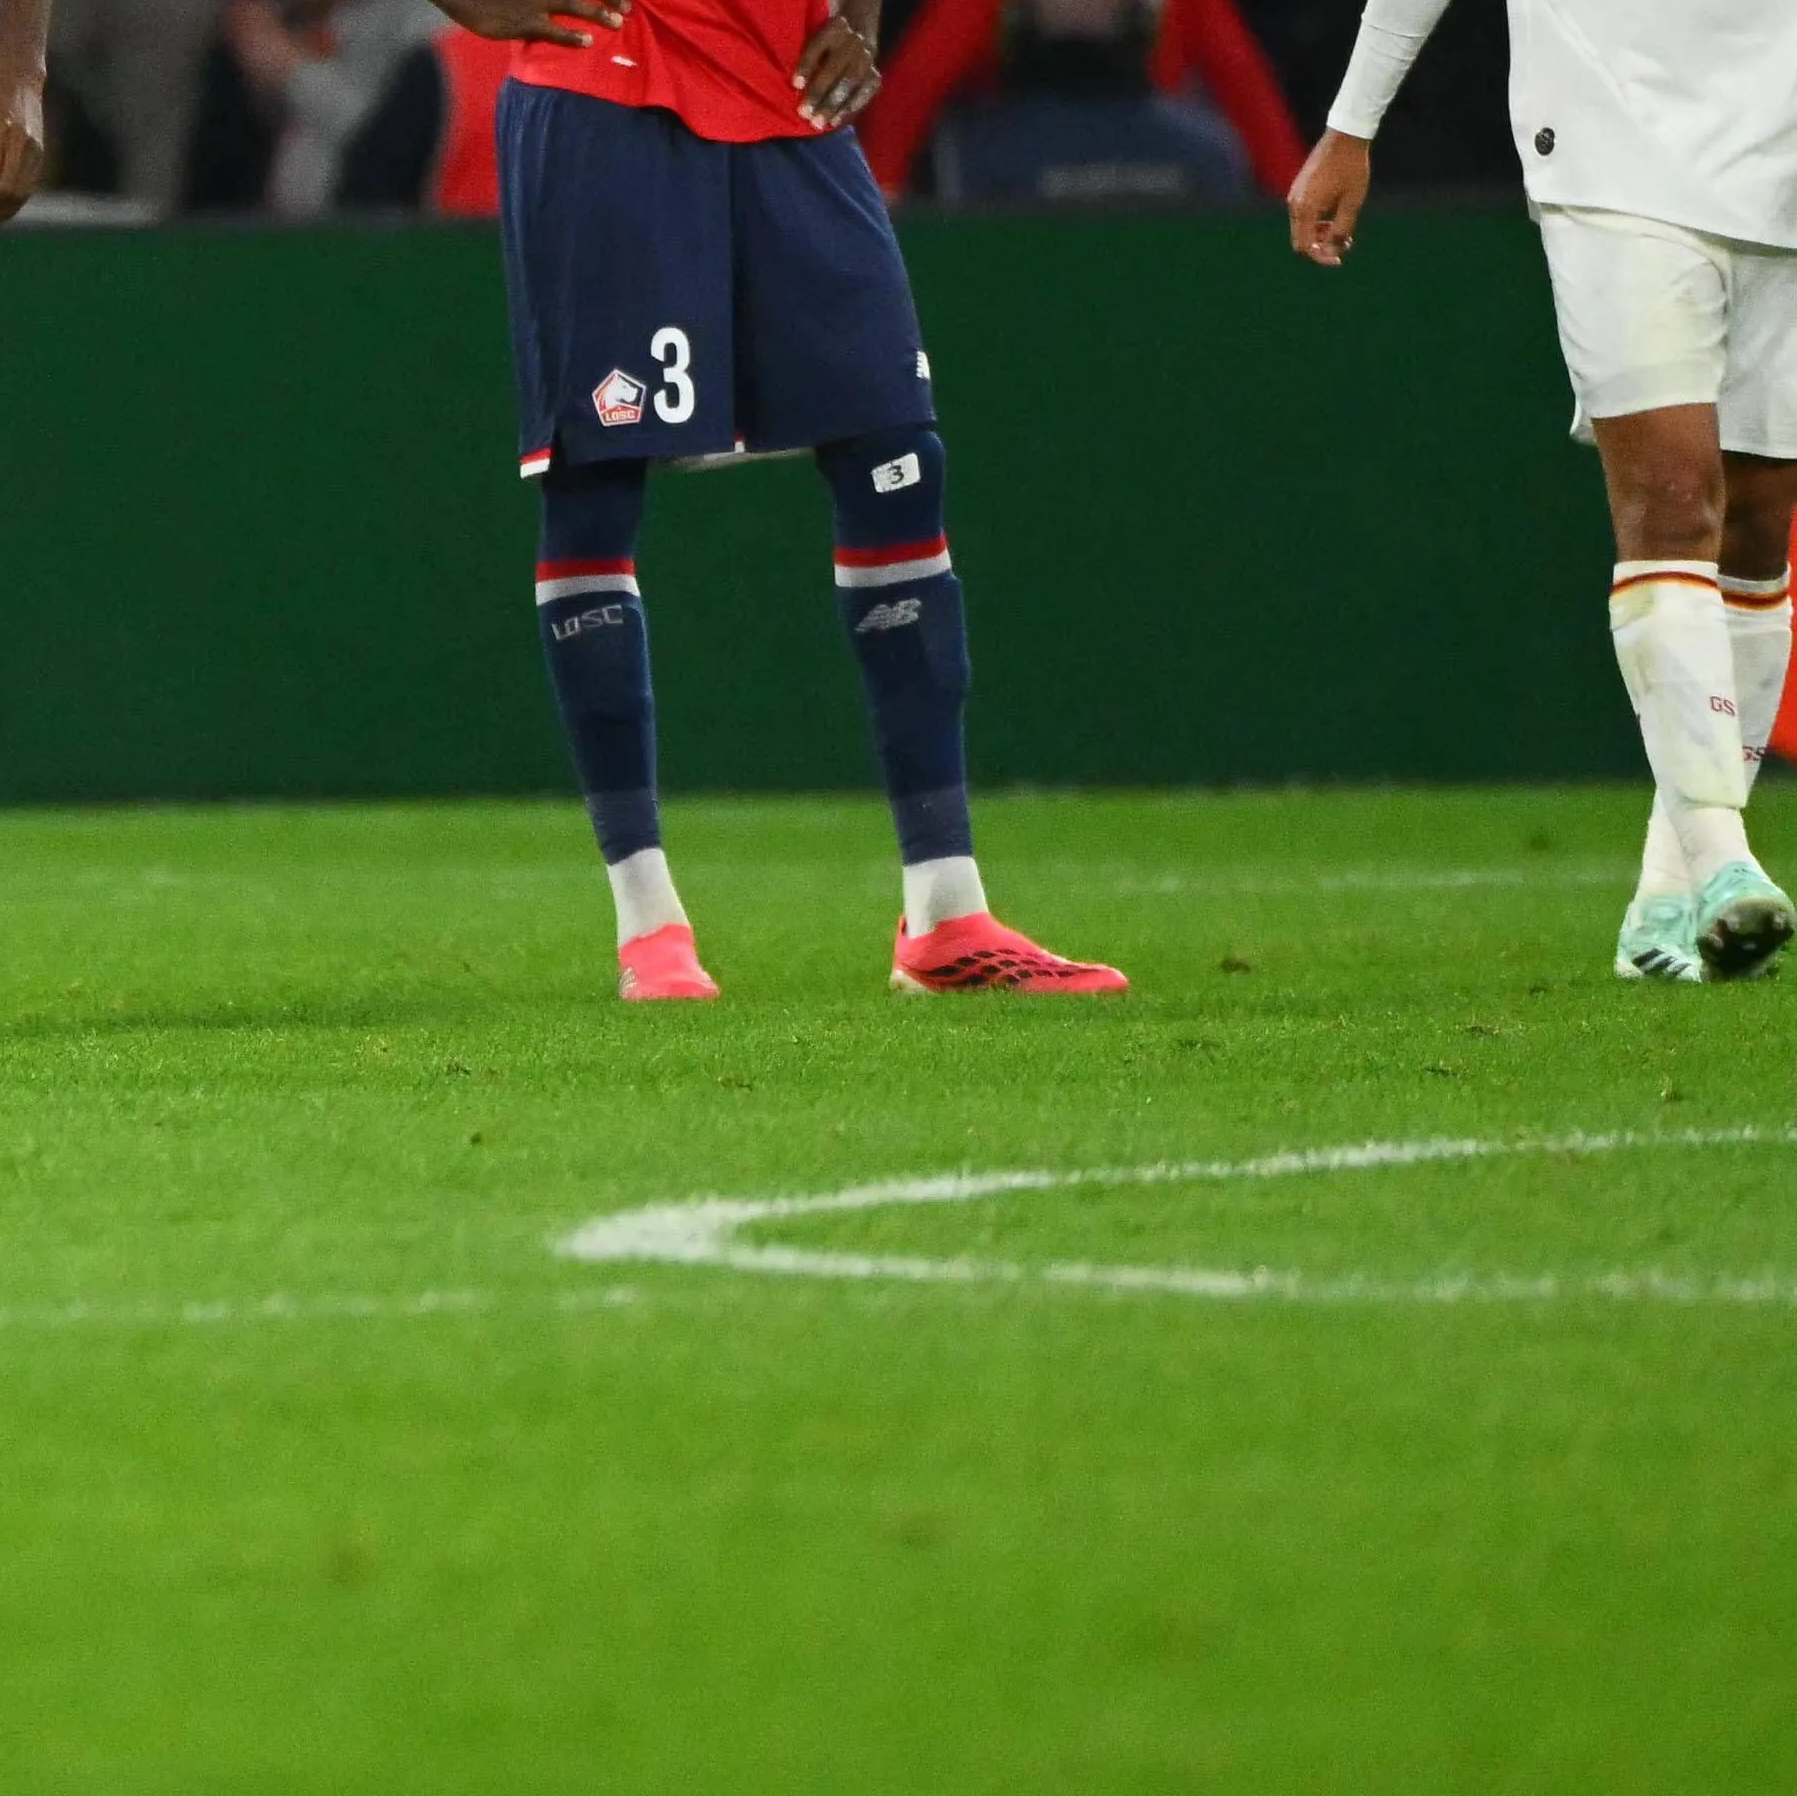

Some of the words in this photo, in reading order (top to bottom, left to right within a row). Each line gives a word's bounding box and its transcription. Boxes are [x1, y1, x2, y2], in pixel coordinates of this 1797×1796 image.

[650, 326, 695, 424] 3
[888, 464, 905, 485] 3
[552, 604, 623, 640] LOSC
[1710, 696, 1735, 716] GS
